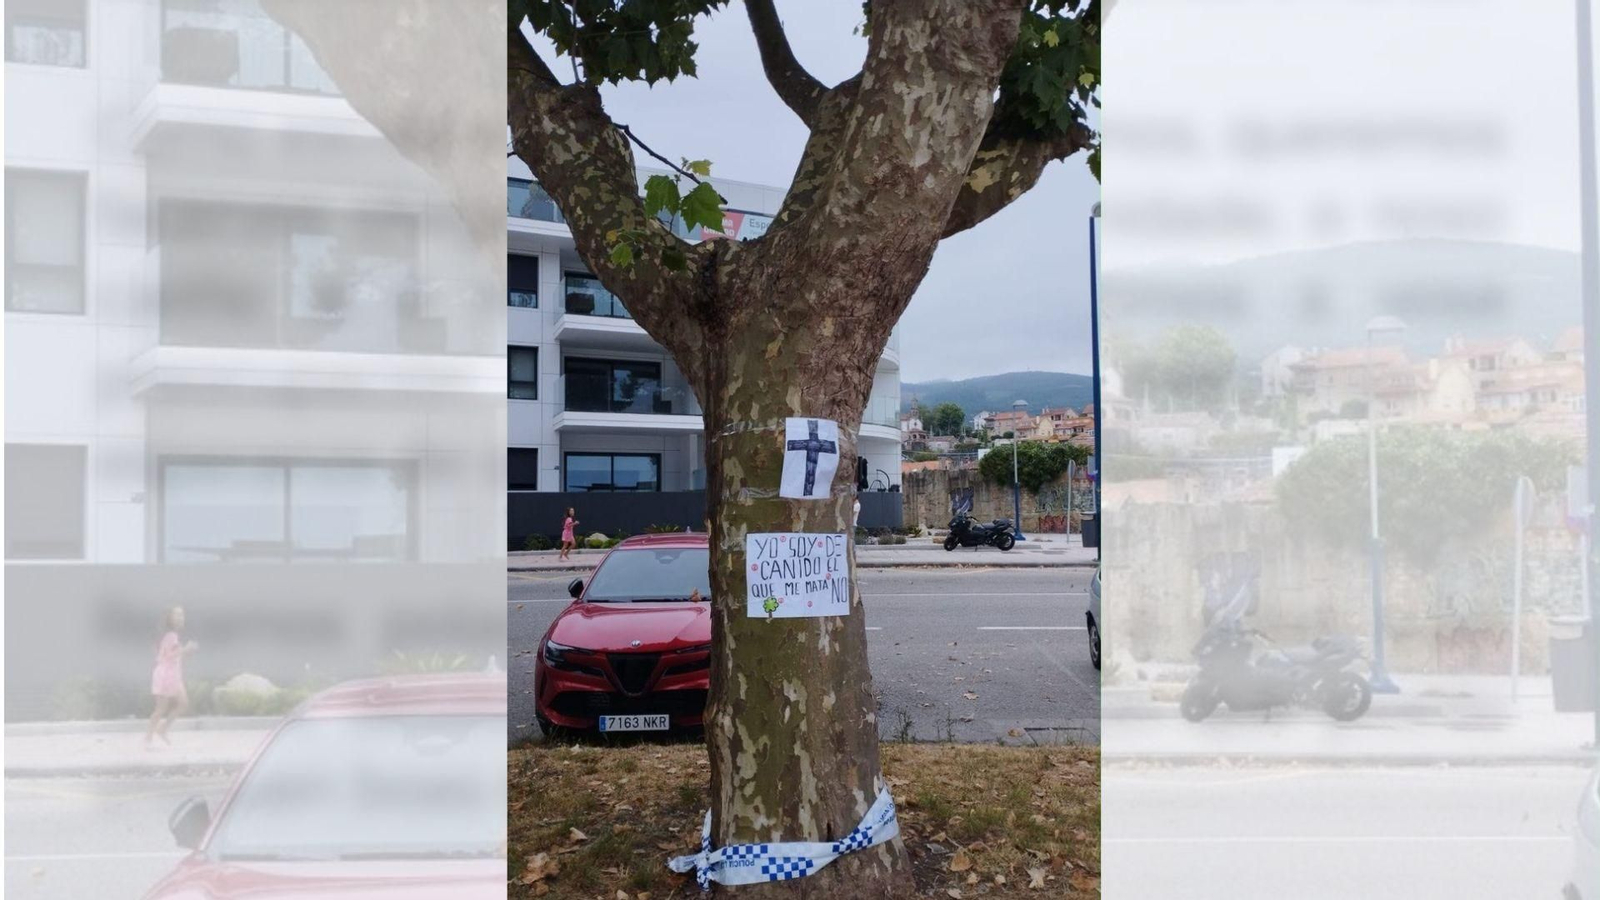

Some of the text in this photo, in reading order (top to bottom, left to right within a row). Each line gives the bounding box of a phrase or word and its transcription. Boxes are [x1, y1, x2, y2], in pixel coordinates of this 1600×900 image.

[755, 535, 842, 559] YO SOY DE
[761, 557, 839, 580] CANIDO EL
[751, 577, 848, 604] QUE ME MATA NO
[608, 716, 667, 729] 7163 NKR
